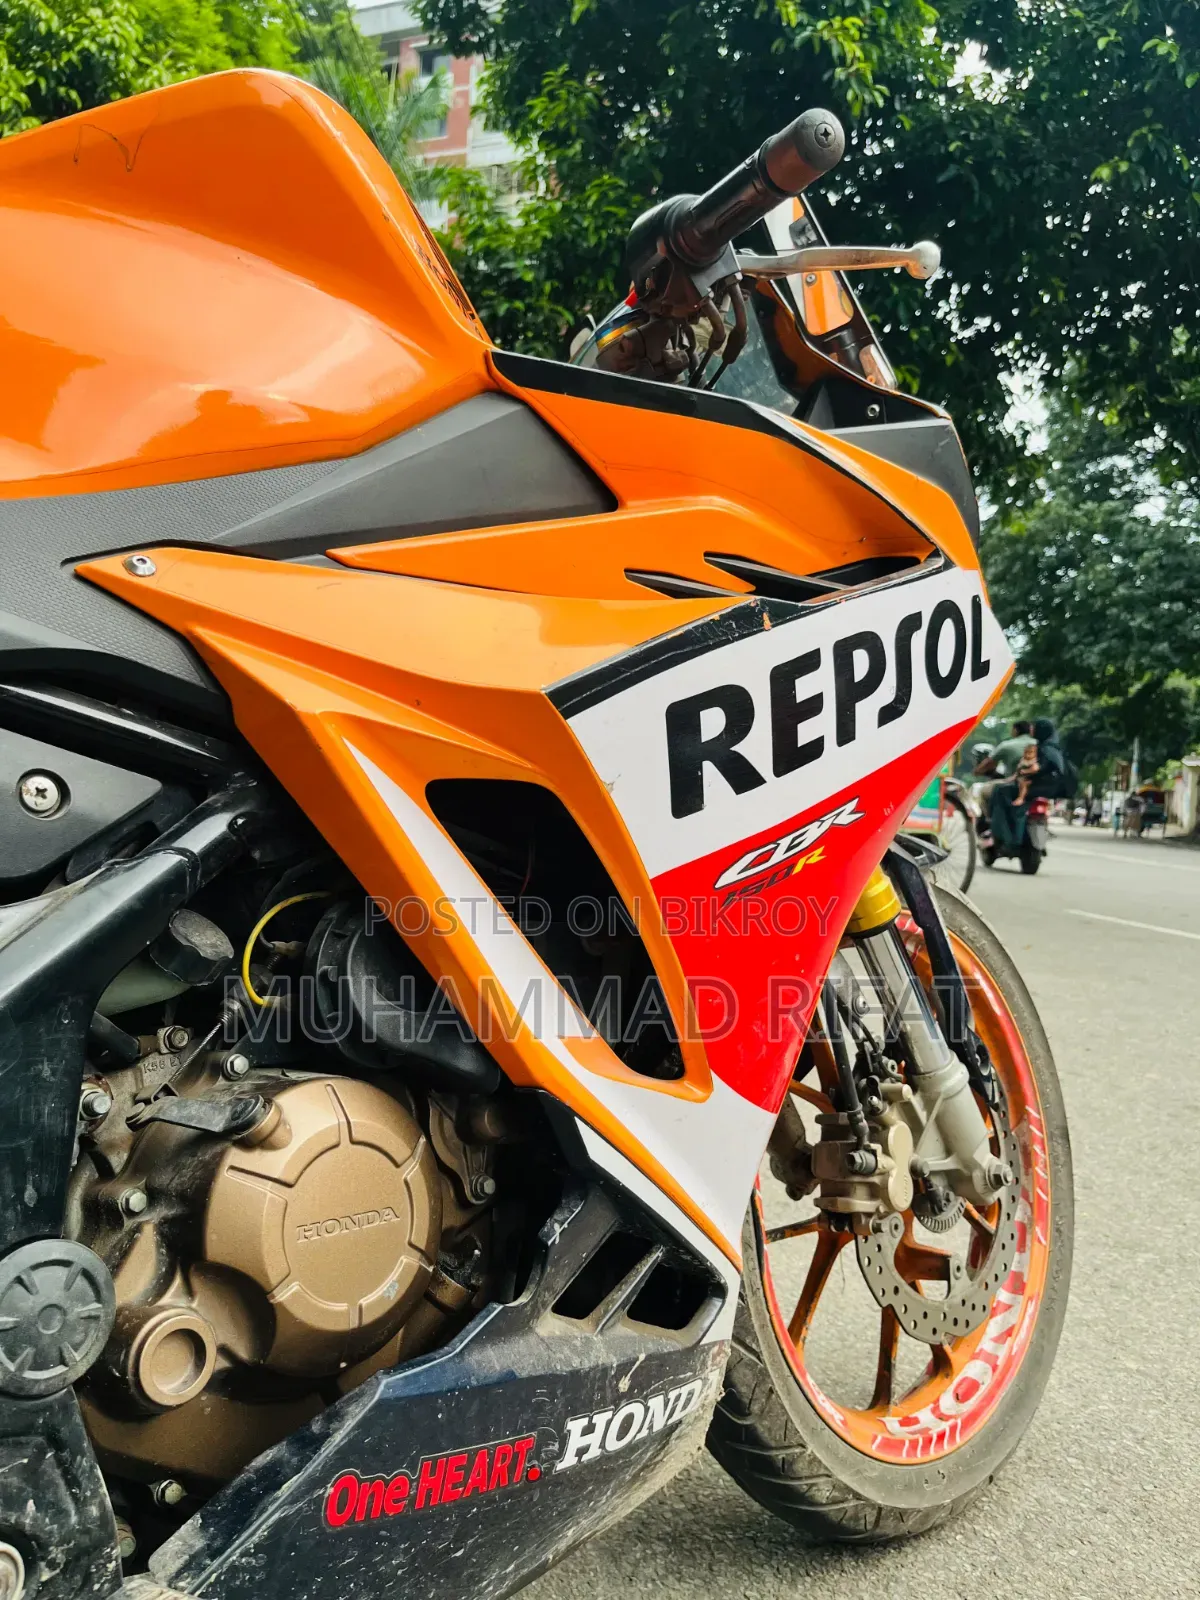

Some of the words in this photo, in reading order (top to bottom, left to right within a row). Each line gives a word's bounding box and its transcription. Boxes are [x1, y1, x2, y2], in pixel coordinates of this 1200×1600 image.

[665, 594, 991, 820] REPSOL
[713, 795, 867, 891] CBR
[296, 1206, 401, 1244] HONDA
[876, 1160, 1032, 1437] HOND
[326, 1474, 410, 1528] One
